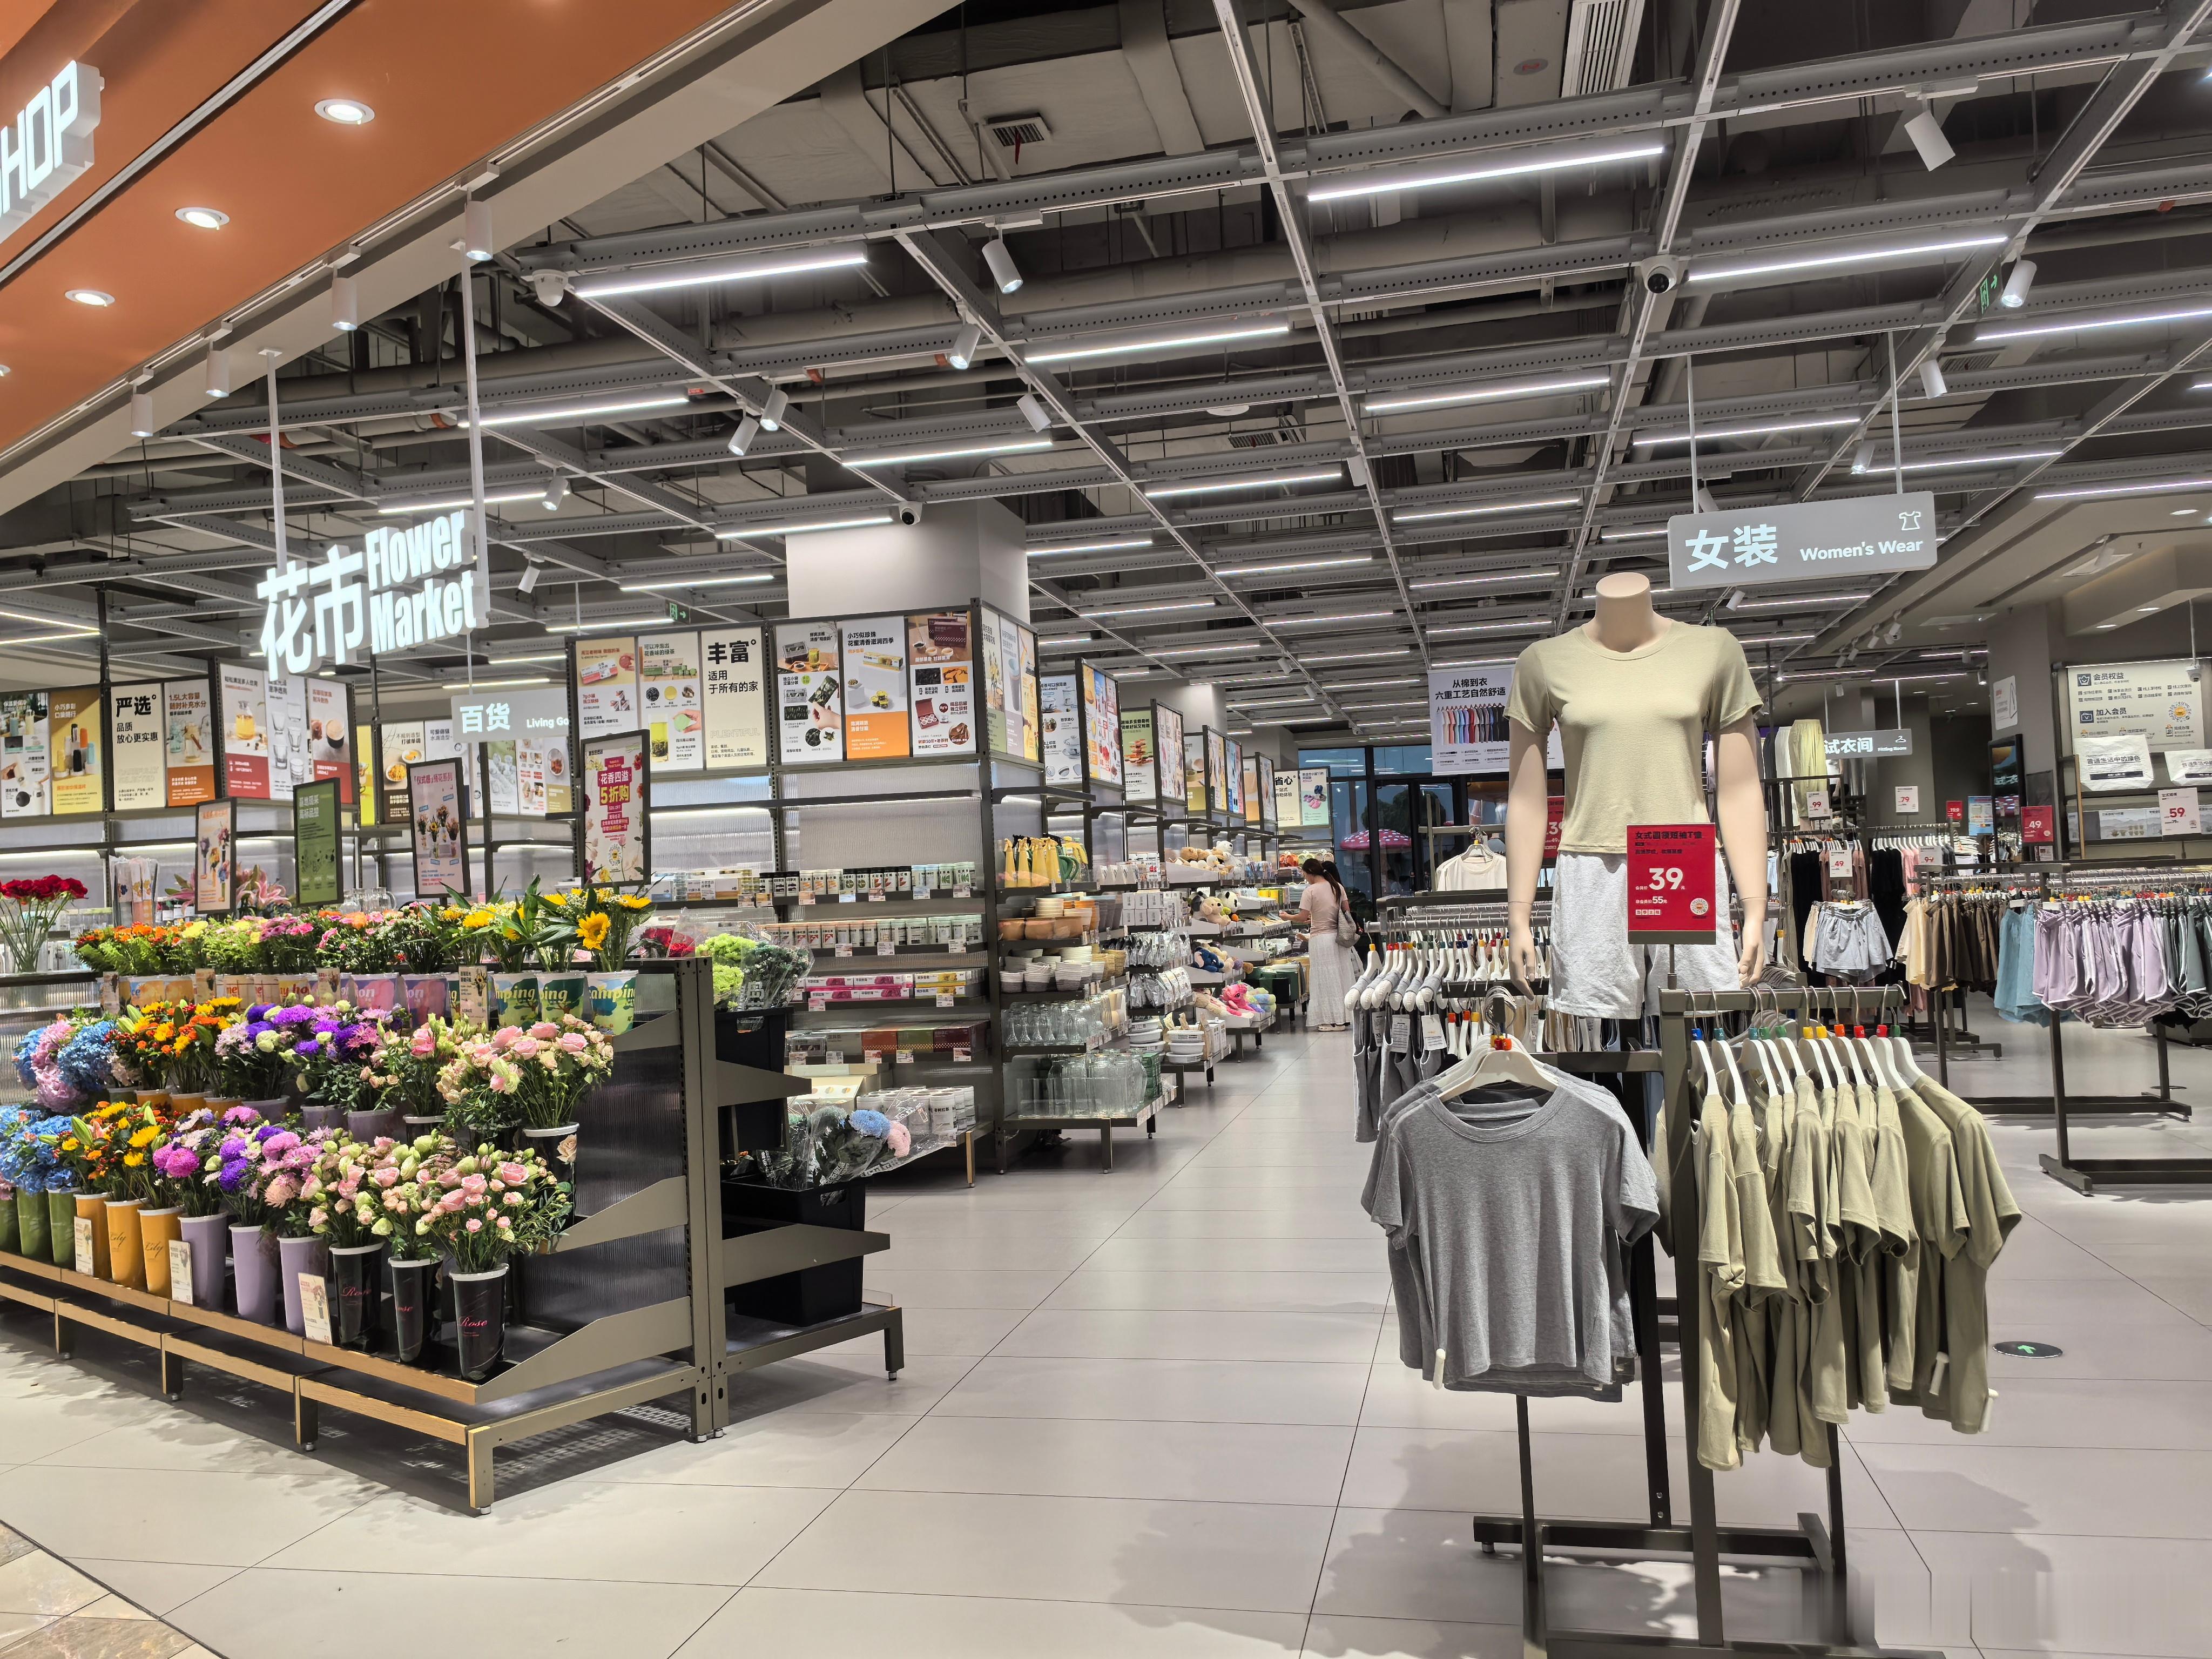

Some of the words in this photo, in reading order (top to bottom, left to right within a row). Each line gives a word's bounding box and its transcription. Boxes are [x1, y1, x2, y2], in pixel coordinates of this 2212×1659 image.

[0, 60, 78, 216] HOP
[365, 509, 464, 591] Flower
[1685, 524, 1778, 573] 女装
[1800, 542, 1874, 561] Women's
[1878, 538, 1923, 555] Wear
[257, 544, 364, 682] 花市
[370, 570, 476, 655] Market
[847, 631, 876, 639] 小巧似珍珠
[708, 670, 727, 681] 适用
[2093, 672, 2125, 681] 会员权益
[708, 680, 758, 694] 于所有的家
[1452, 678, 1488, 688] 从棉到衣
[1435, 687, 1506, 700] 六重工艺自然舒适
[2096, 707, 2127, 716] 加入会员
[460, 703, 511, 734] 百货
[526, 718, 554, 729] Living
[117, 721, 133, 732] 品质
[117, 732, 158, 744] 放心更实惠
[710, 727, 761, 739] PLENTIFUL
[1824, 737, 1873, 754] 试衣间
[600, 770, 629, 785] 花香四溢
[600, 784, 629, 804] 5折购
[2169, 807, 2185, 818] 59
[2028, 820, 2042, 828] 49
[1648, 867, 1683, 891] 39
[1652, 896, 1663, 904] 55
[396, 1305, 414, 1313] ose
[458, 1316, 488, 1328] Rose
